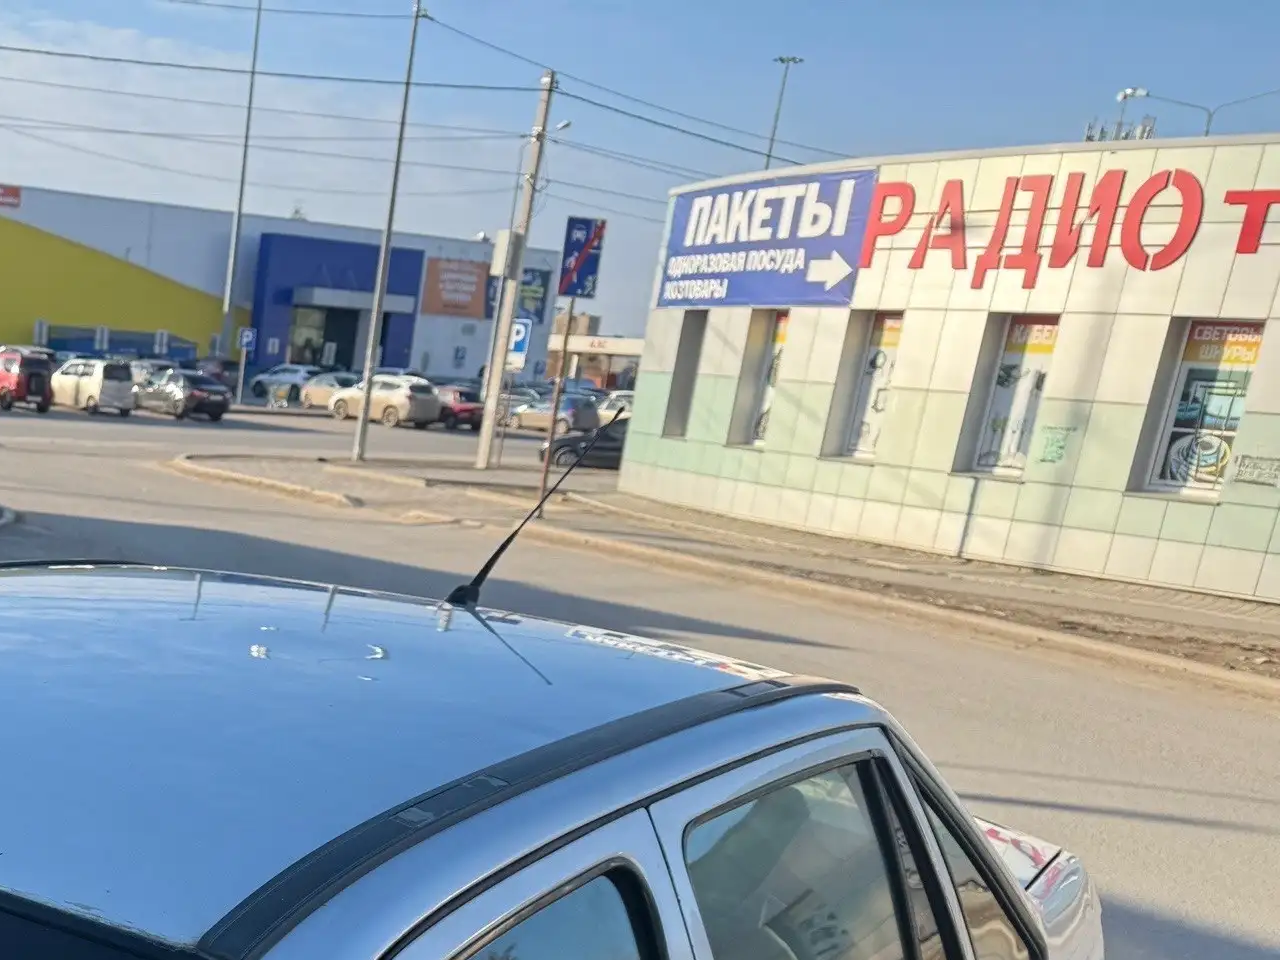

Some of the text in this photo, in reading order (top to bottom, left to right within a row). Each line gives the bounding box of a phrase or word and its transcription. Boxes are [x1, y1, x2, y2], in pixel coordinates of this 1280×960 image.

[683, 179, 857, 247] ПАКЕТЫ
[857, 168, 1204, 290] РАДИО
[746, 248, 807, 274] ПОСУДА
[1193, 325, 1263, 342] СВЕТОВЫ
